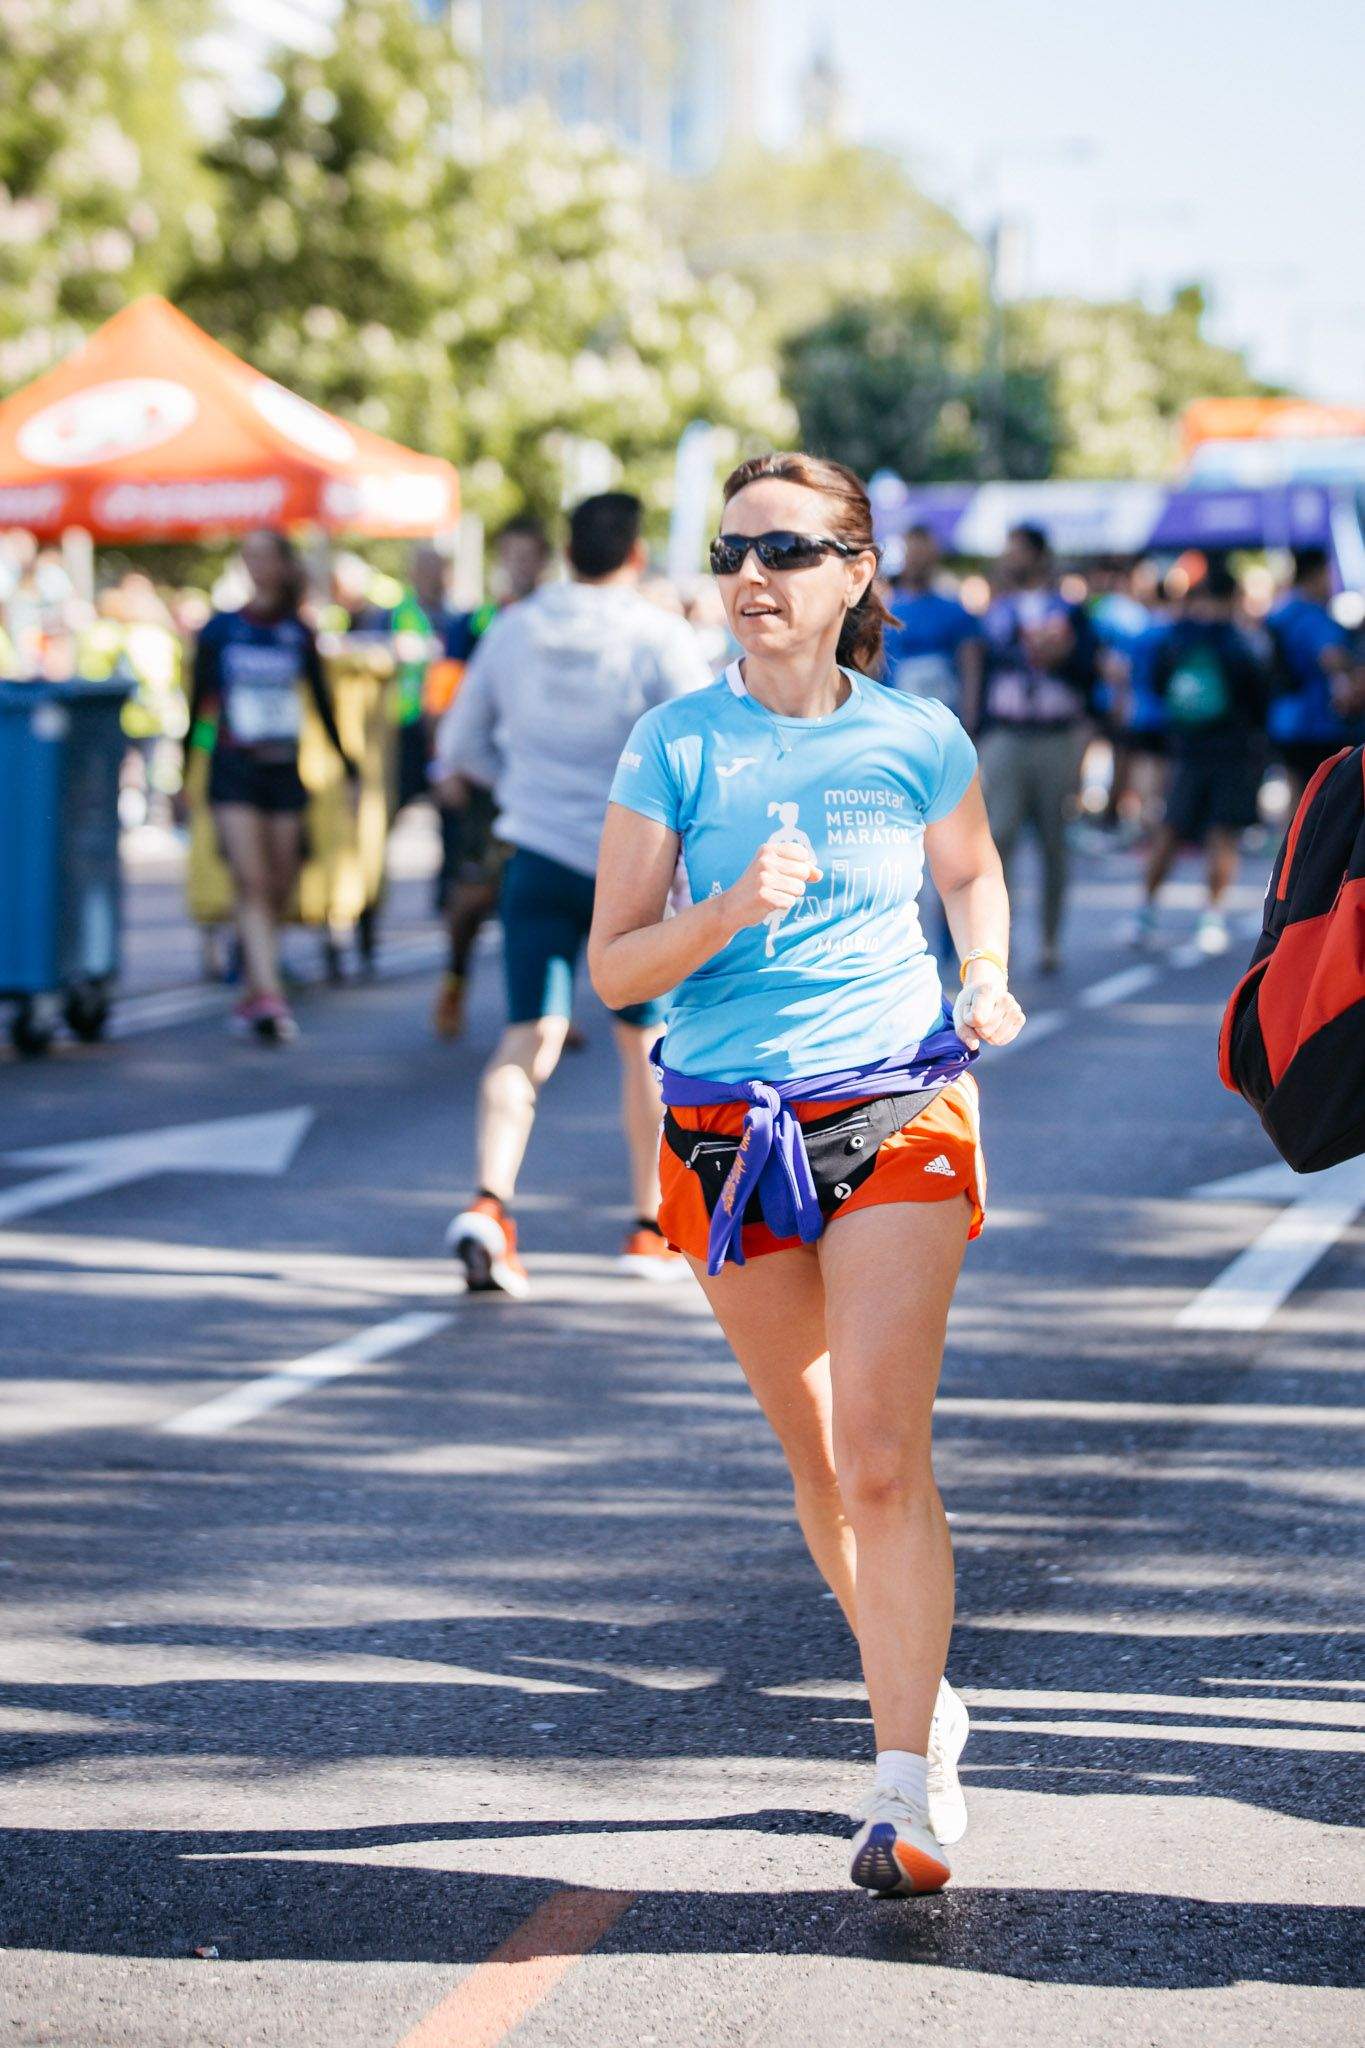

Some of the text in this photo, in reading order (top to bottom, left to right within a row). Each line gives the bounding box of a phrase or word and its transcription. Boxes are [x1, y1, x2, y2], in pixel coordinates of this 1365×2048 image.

[824, 789, 904, 809] movistar
[826, 810, 886, 826] MEDIO
[924, 1165, 956, 1177] adidas
